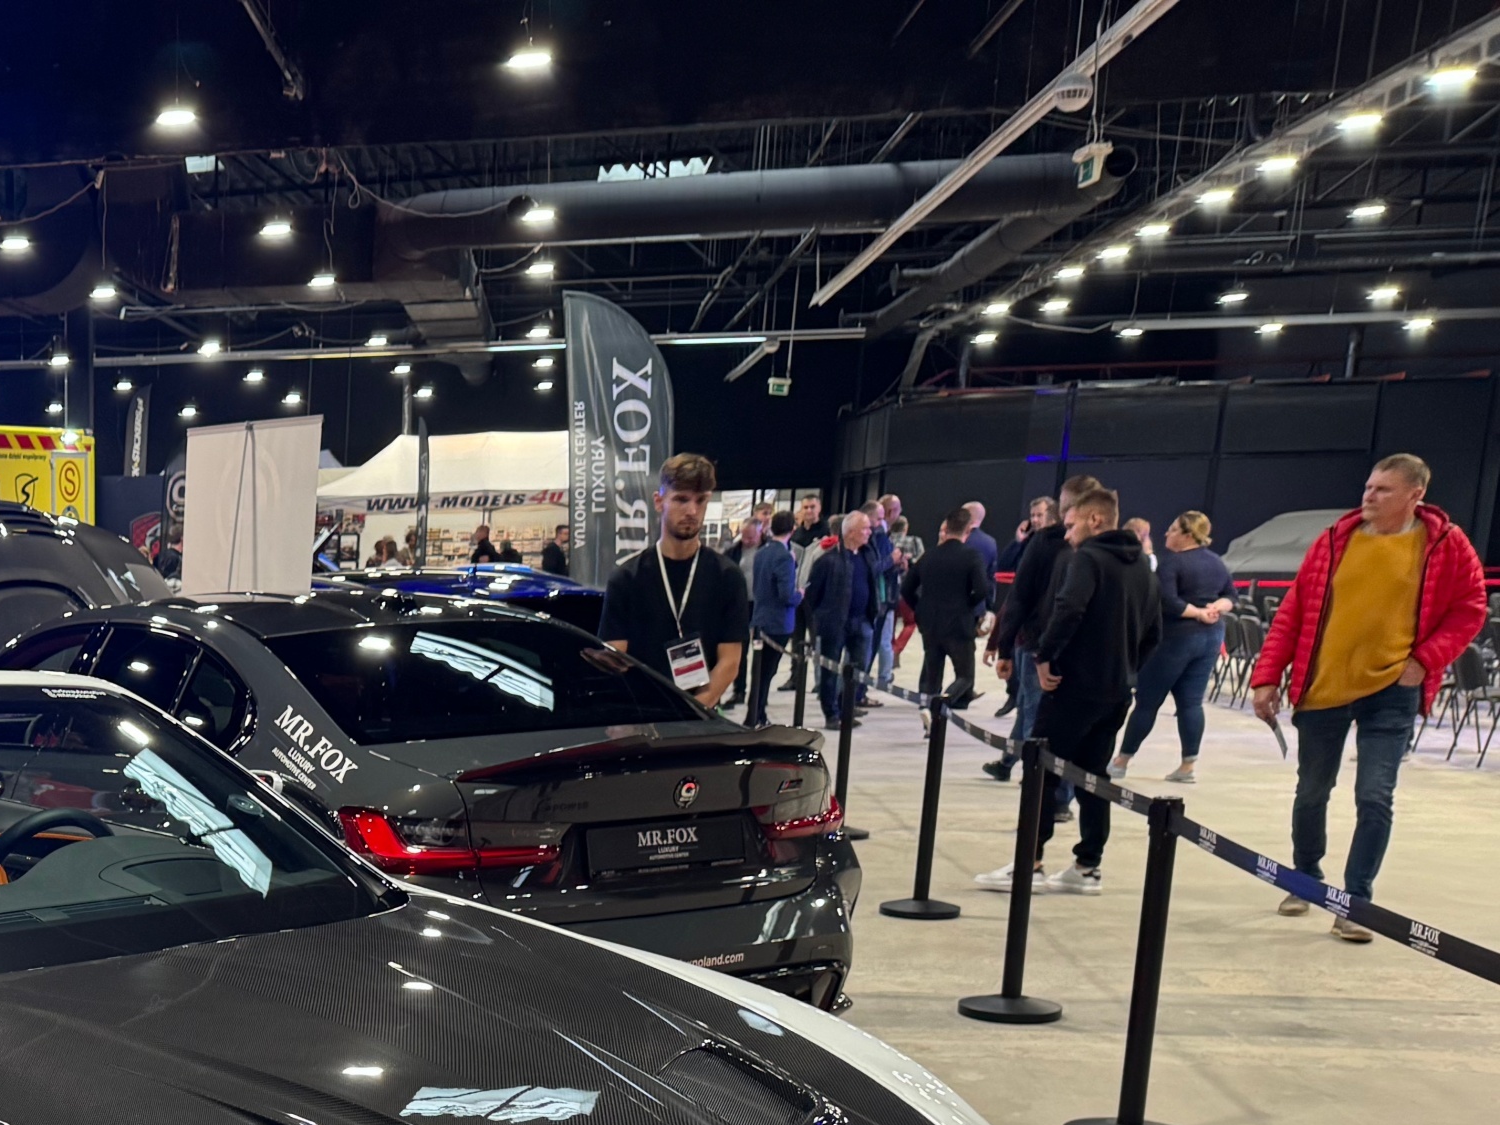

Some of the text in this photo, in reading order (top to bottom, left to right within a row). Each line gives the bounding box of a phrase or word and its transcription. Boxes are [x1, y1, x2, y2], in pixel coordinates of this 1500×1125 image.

[274, 704, 358, 784] MR.FOX
[287, 746, 316, 775] LUXURY
[637, 826, 699, 848] MR.FOX
[1326, 886, 1352, 908] MR.FOX
[1409, 921, 1440, 946] MR.FOX
